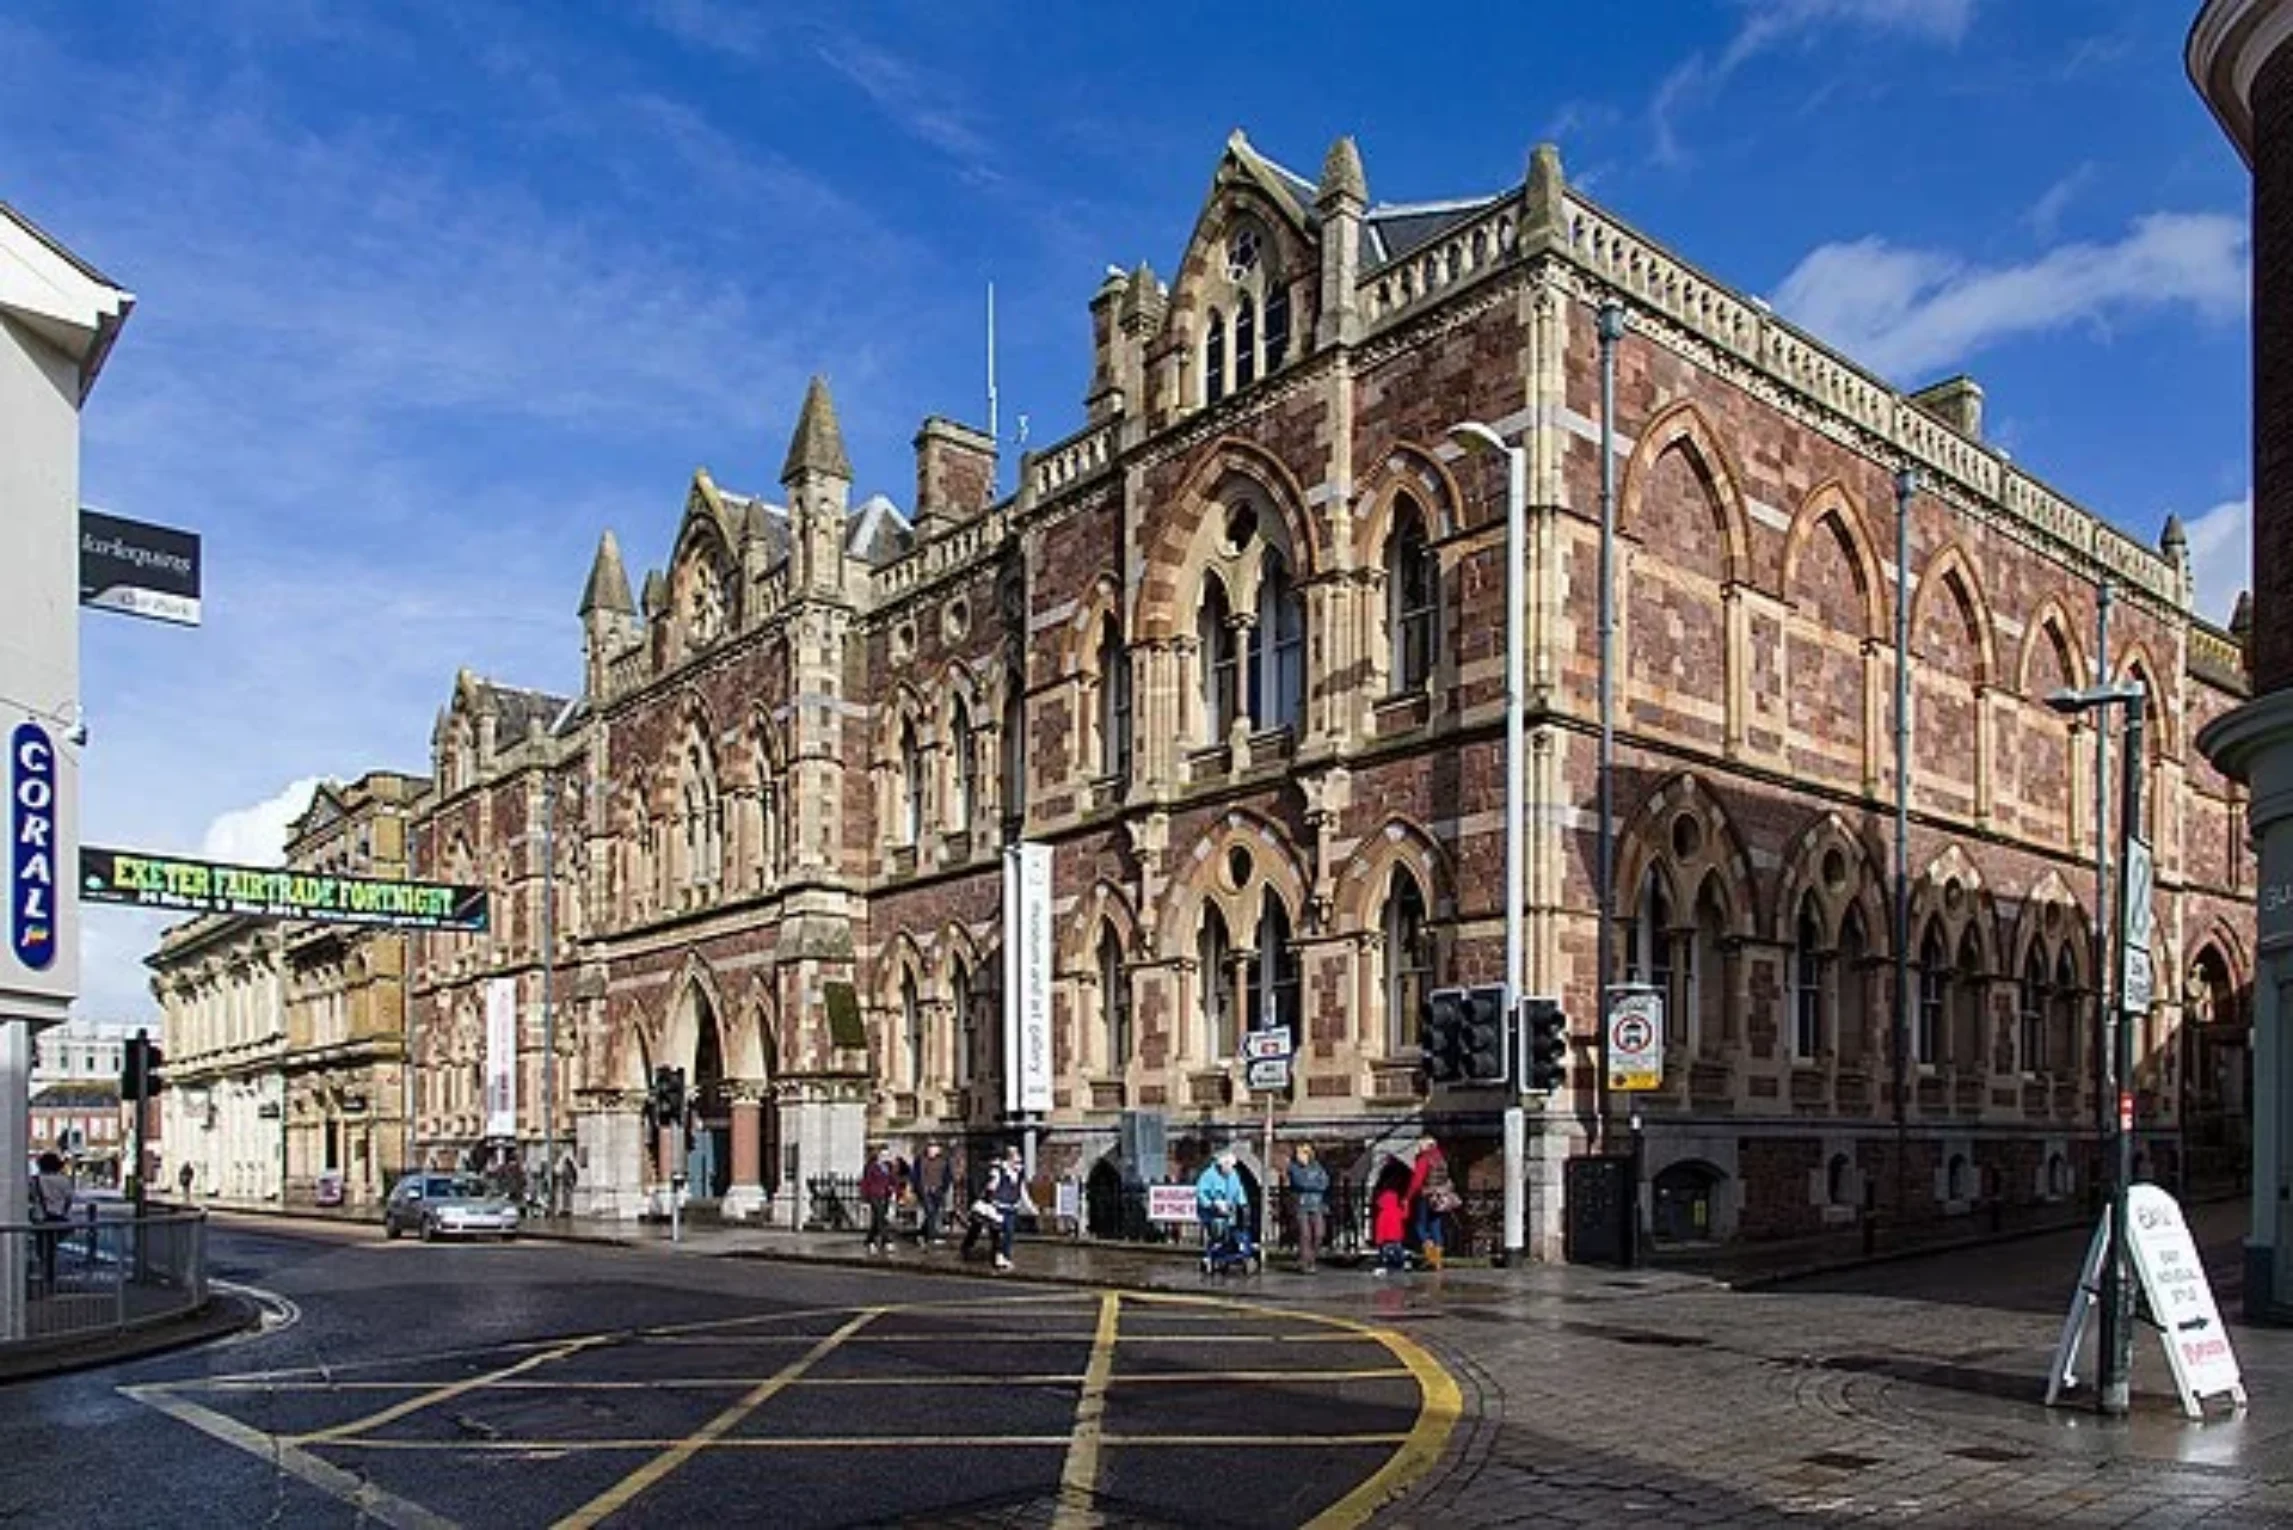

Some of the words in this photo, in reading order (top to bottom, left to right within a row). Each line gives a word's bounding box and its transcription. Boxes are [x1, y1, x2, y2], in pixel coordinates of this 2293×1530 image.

[17, 741, 51, 919] CORAL
[113, 855, 209, 897] EXETER
[213, 867, 336, 908] FAIRTRADE
[339, 880, 454, 915] FORTNIGHT
